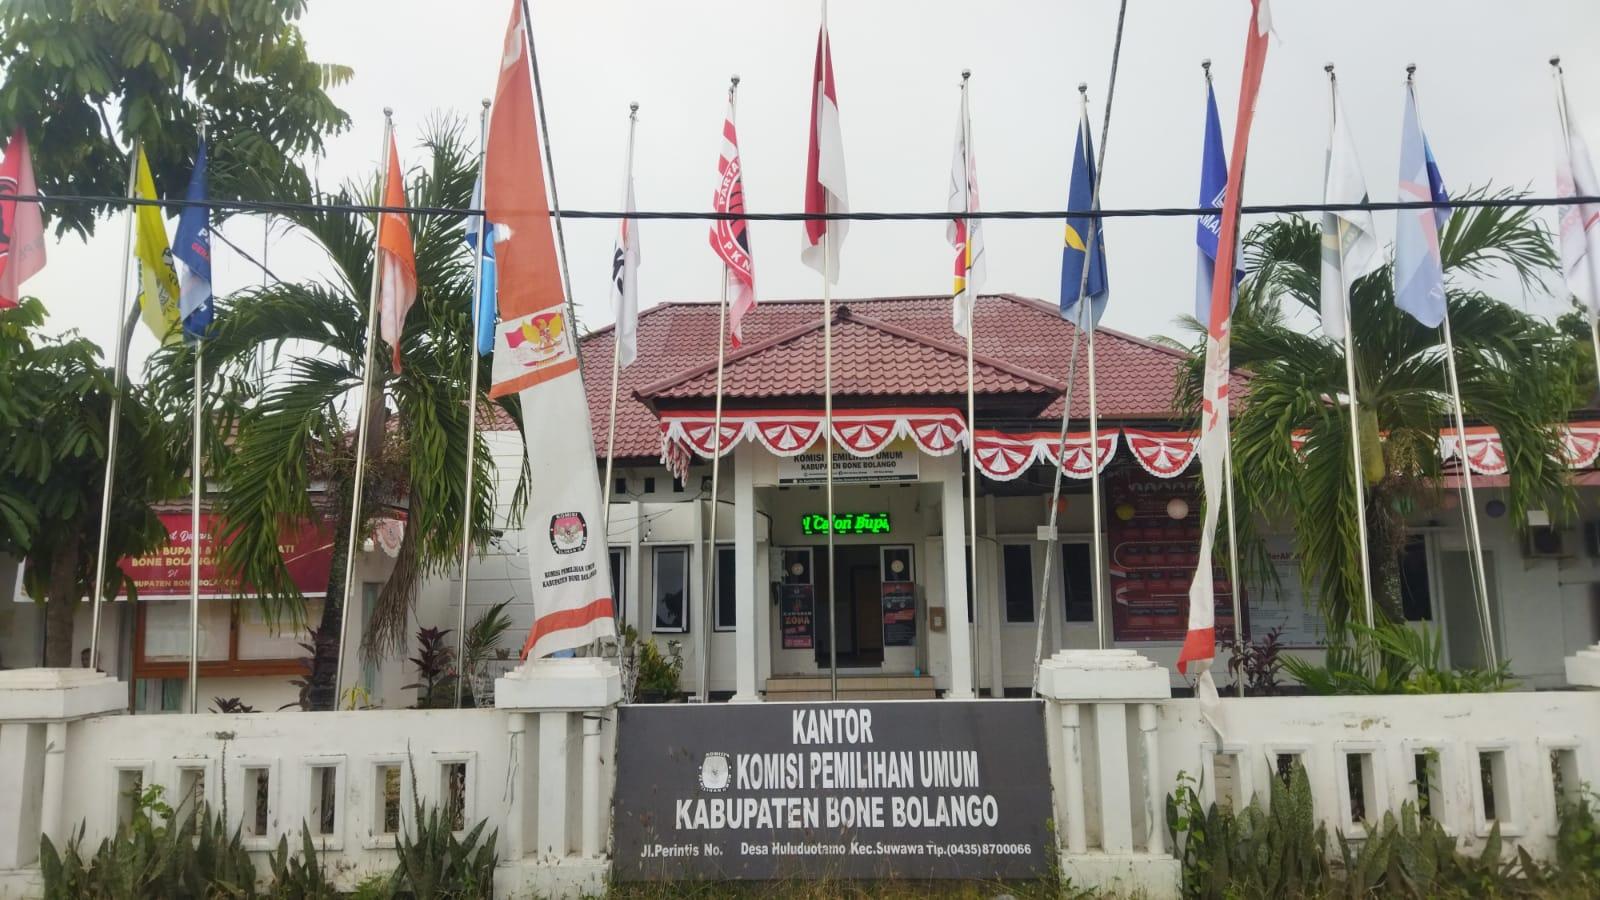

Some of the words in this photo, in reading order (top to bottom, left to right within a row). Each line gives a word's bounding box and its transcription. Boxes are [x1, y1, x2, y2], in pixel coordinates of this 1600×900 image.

[793, 453, 824, 463] KOMISI
[876, 450, 903, 460] UMUM
[801, 463, 841, 471] KABUPAEN
[842, 461, 862, 469] BONE
[863, 460, 897, 468] BOLANGO
[163, 546, 202, 556] BUPAI
[132, 557, 162, 567] BONE
[166, 557, 220, 567] BOLAGO
[792, 708, 874, 745] KANTOR
[736, 752, 804, 790] KOMISI
[810, 751, 914, 789] PEMILIHAN
[919, 750, 979, 788] UMUM
[675, 797, 819, 830] KABUPATEN
[825, 796, 885, 829] BONE
[891, 794, 999, 828] BOLANGO
[704, 843, 723, 857] No.
[740, 841, 769, 856] Desa
[850, 841, 924, 855] Kec.Suwawa
